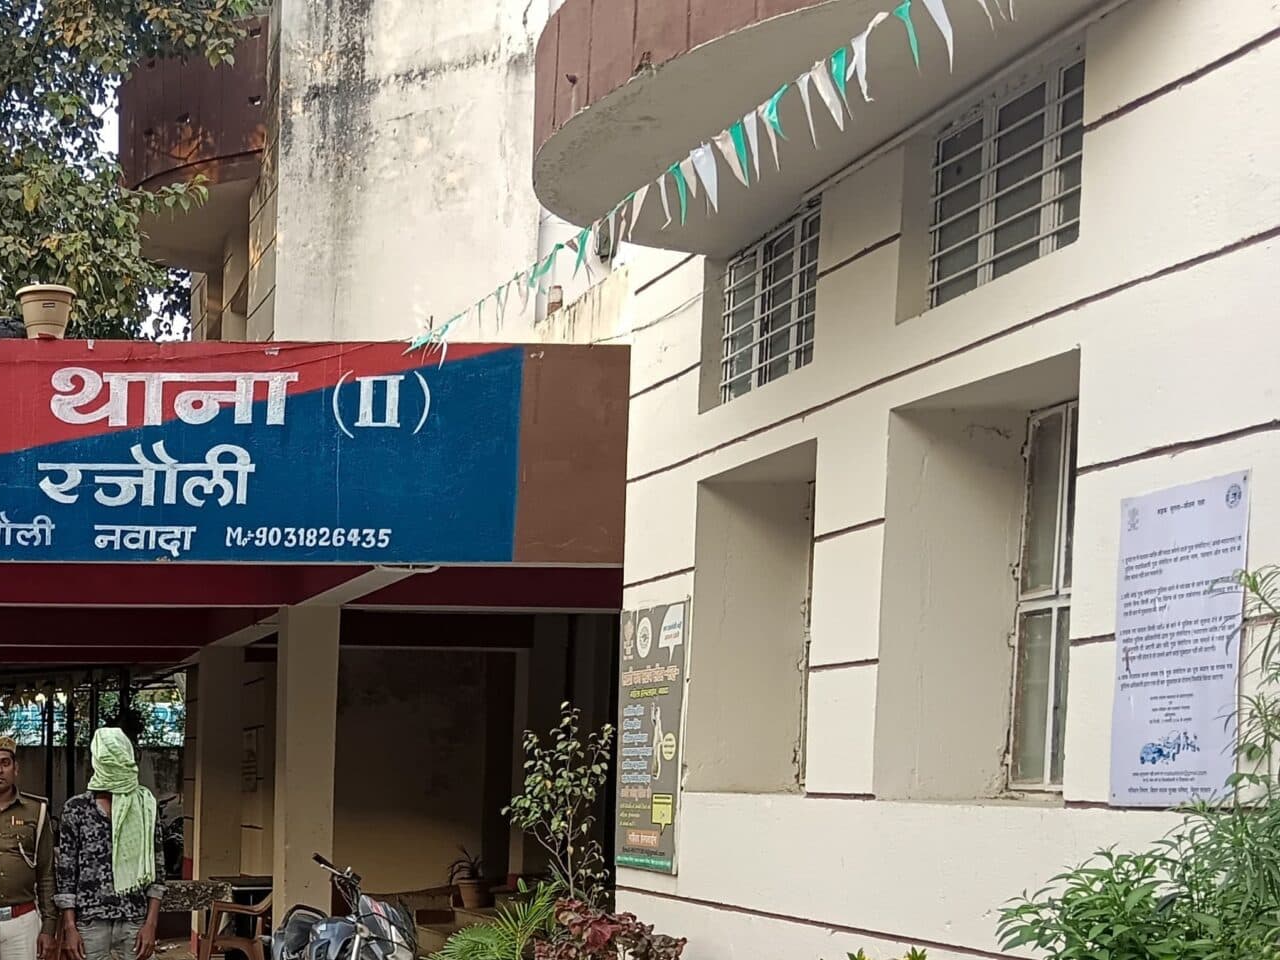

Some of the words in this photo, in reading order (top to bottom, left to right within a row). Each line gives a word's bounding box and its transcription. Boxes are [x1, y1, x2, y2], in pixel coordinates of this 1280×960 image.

[50, 366, 299, 427] थाना
[37, 440, 256, 507] रजौली
[94, 523, 197, 558] नवादा
